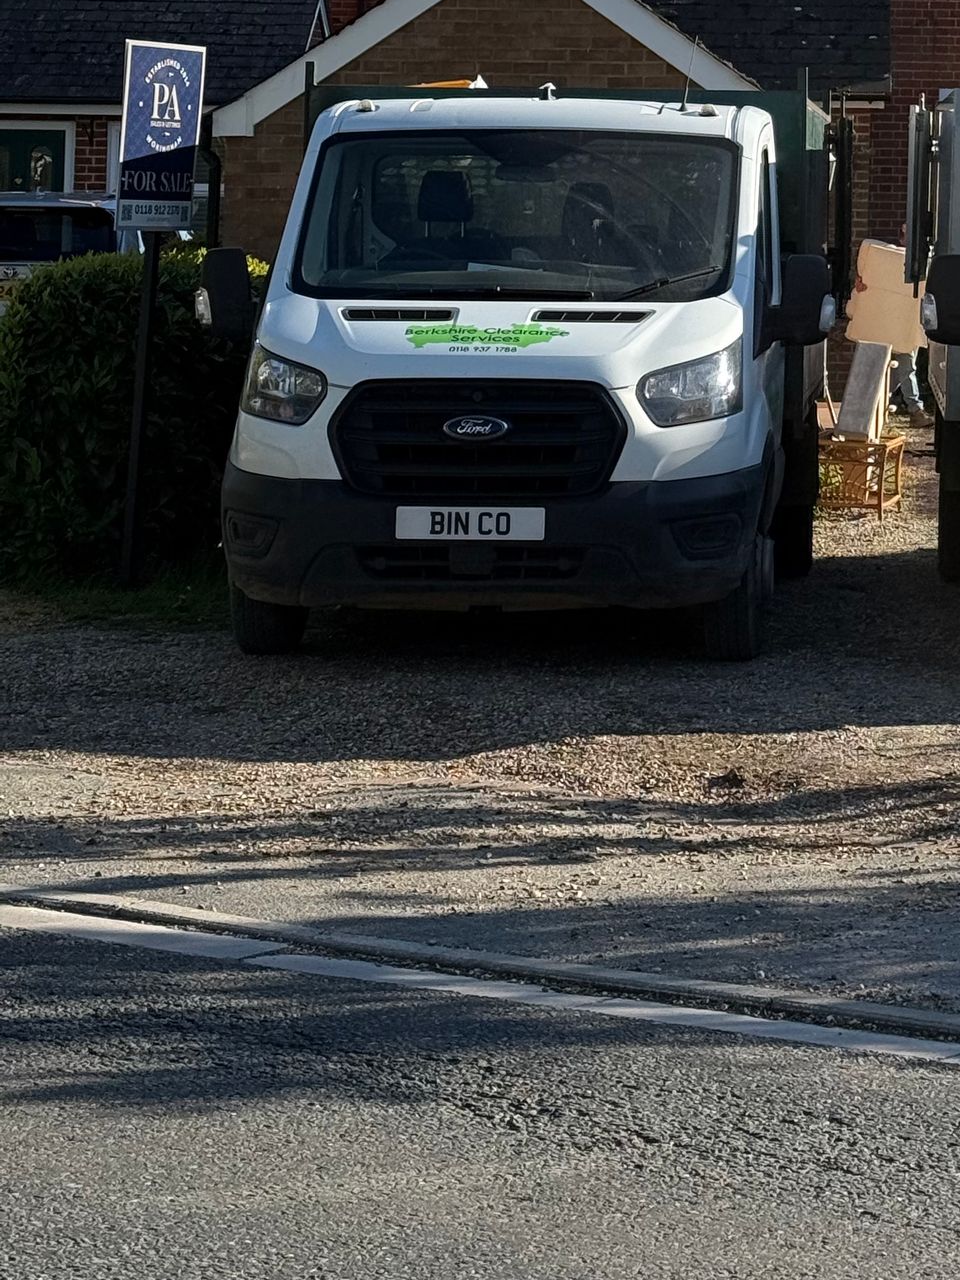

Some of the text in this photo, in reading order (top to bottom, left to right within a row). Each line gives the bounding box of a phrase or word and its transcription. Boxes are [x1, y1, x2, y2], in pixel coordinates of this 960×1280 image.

[151, 82, 181, 120] PA
[123, 170, 191, 193] FOR SALE
[134, 204, 153, 215] 0118
[404, 326, 570, 337] Berkshire Clearance
[450, 334, 521, 343] Services
[456, 419, 493, 434] Ford
[477, 512, 511, 536] CO
